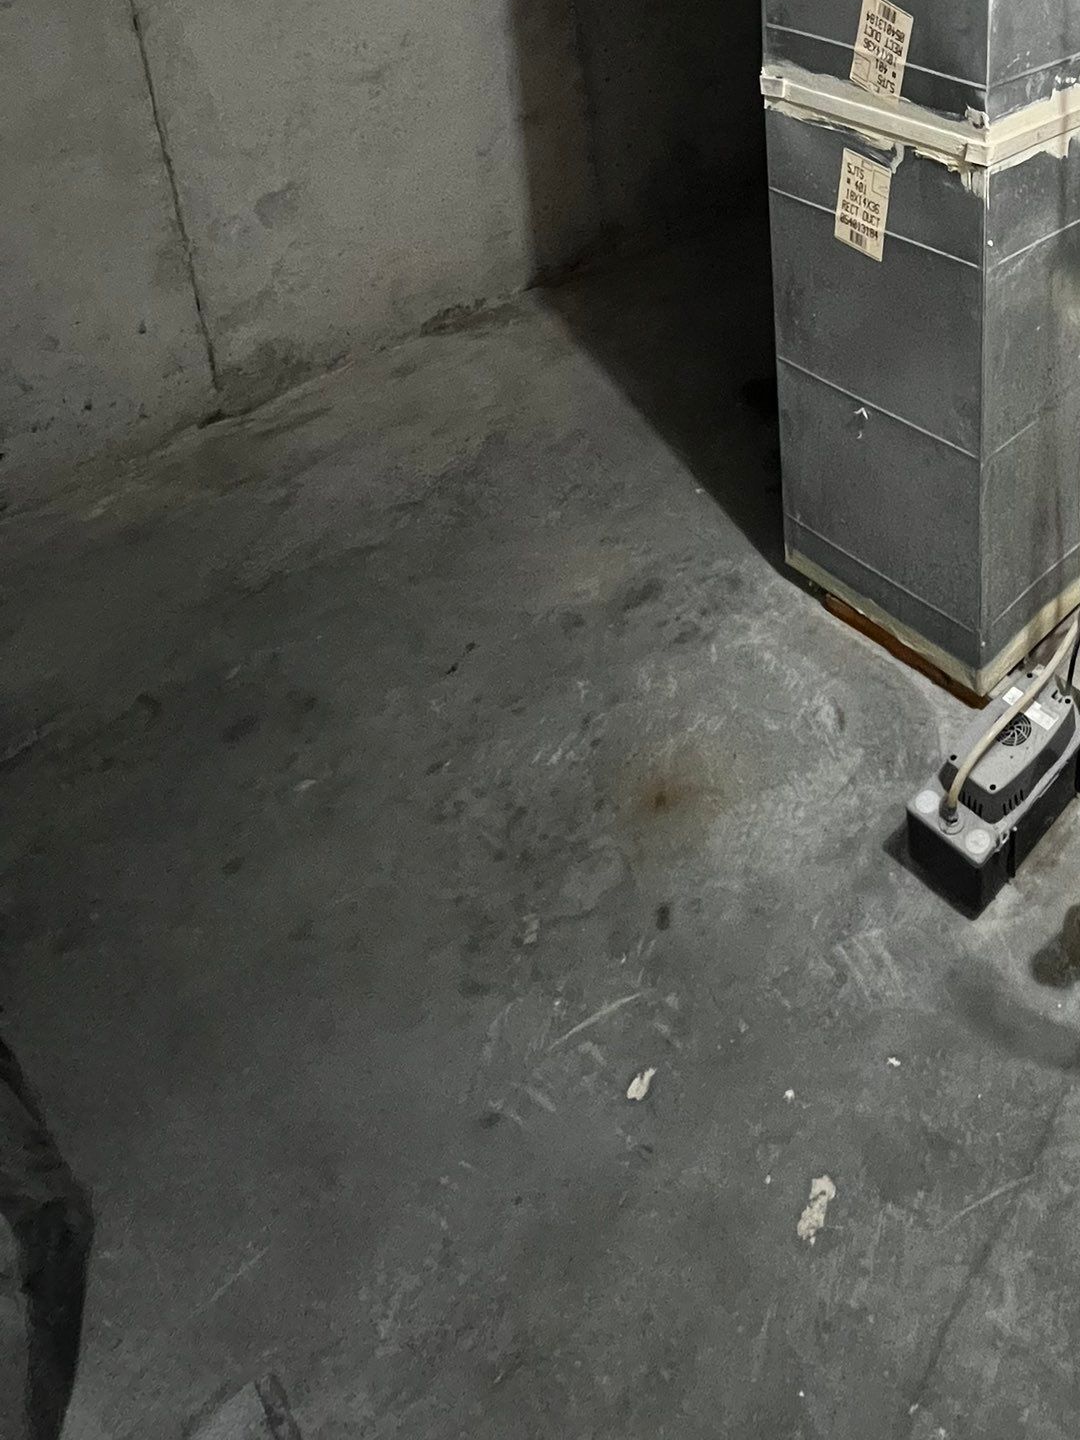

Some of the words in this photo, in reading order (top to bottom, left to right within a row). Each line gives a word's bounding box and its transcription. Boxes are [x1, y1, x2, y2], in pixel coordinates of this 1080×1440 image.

[864, 24, 882, 42] DUCT
[884, 37, 904, 57] RECT
[841, 200, 859, 217] RECT
[861, 210, 881, 228] DUCT
